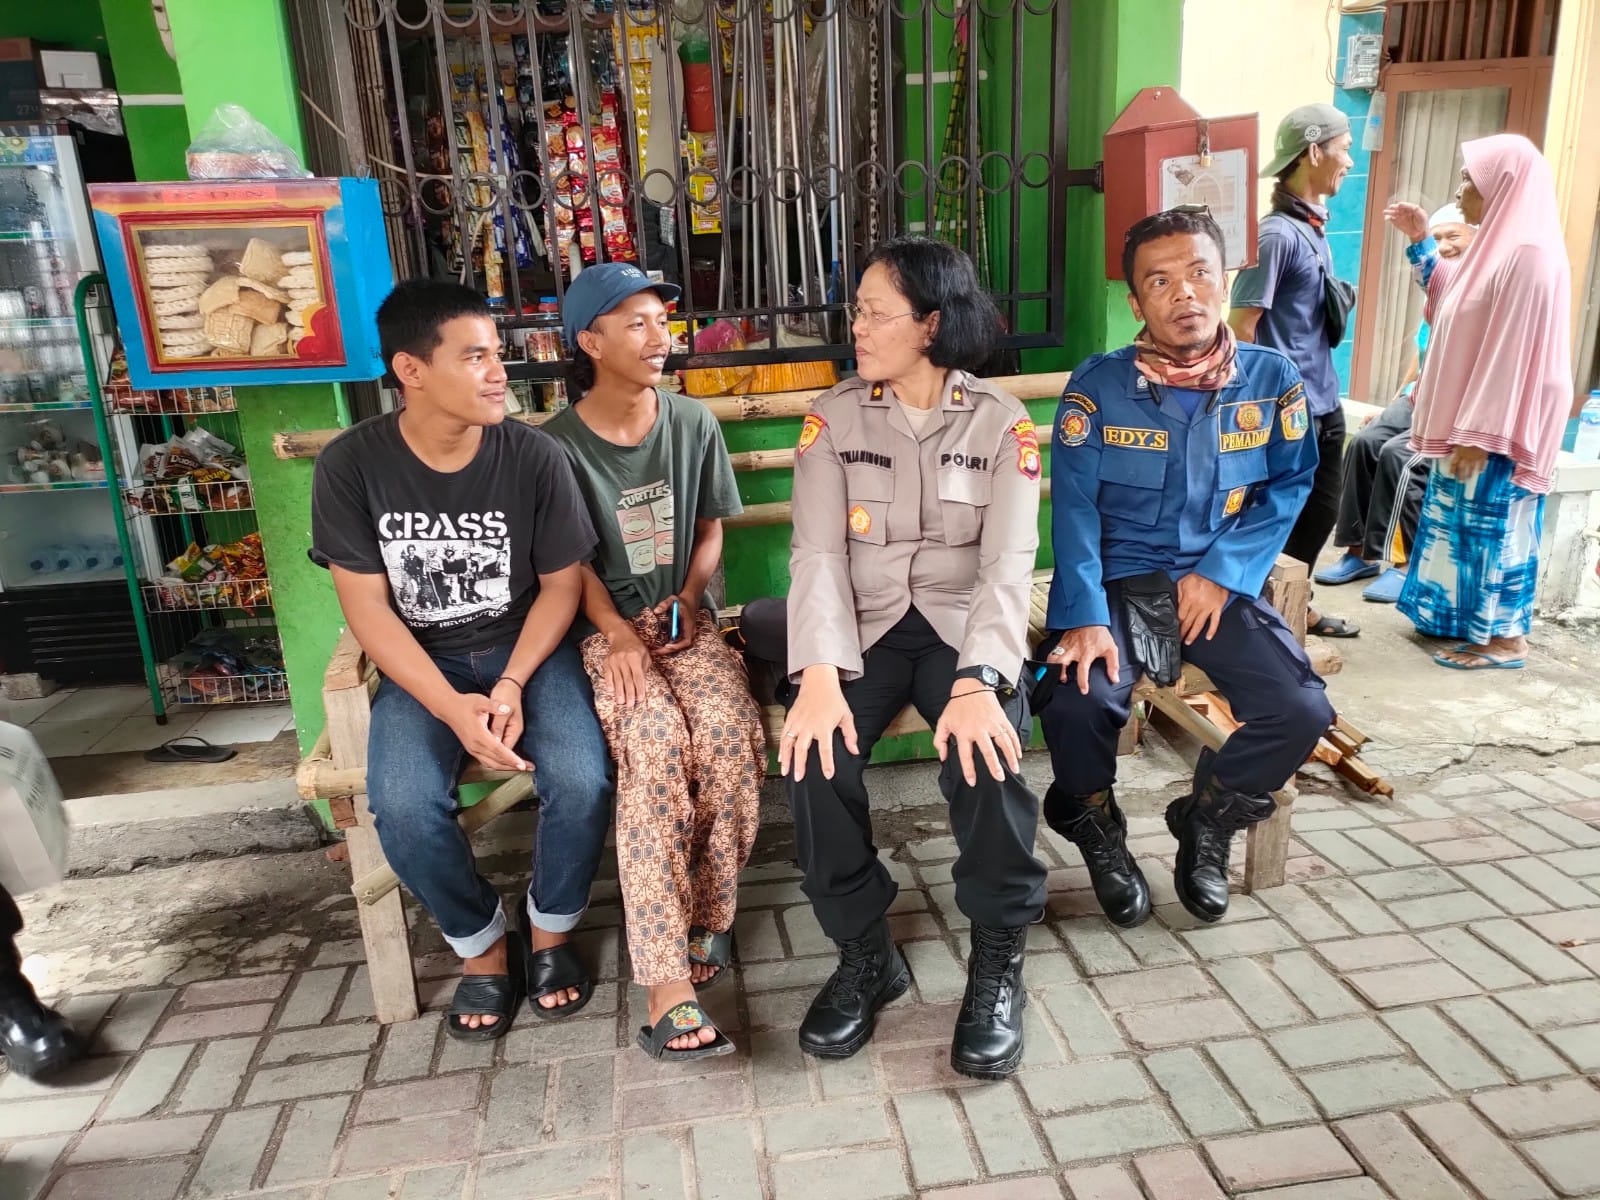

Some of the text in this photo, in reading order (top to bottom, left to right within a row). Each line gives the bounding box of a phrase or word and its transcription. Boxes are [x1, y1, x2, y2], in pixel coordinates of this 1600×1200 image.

[1106, 429, 1165, 448] EDY.S
[941, 453, 988, 471] POLRI
[617, 484, 672, 509] TURTLES
[378, 511, 508, 539] CRASS
